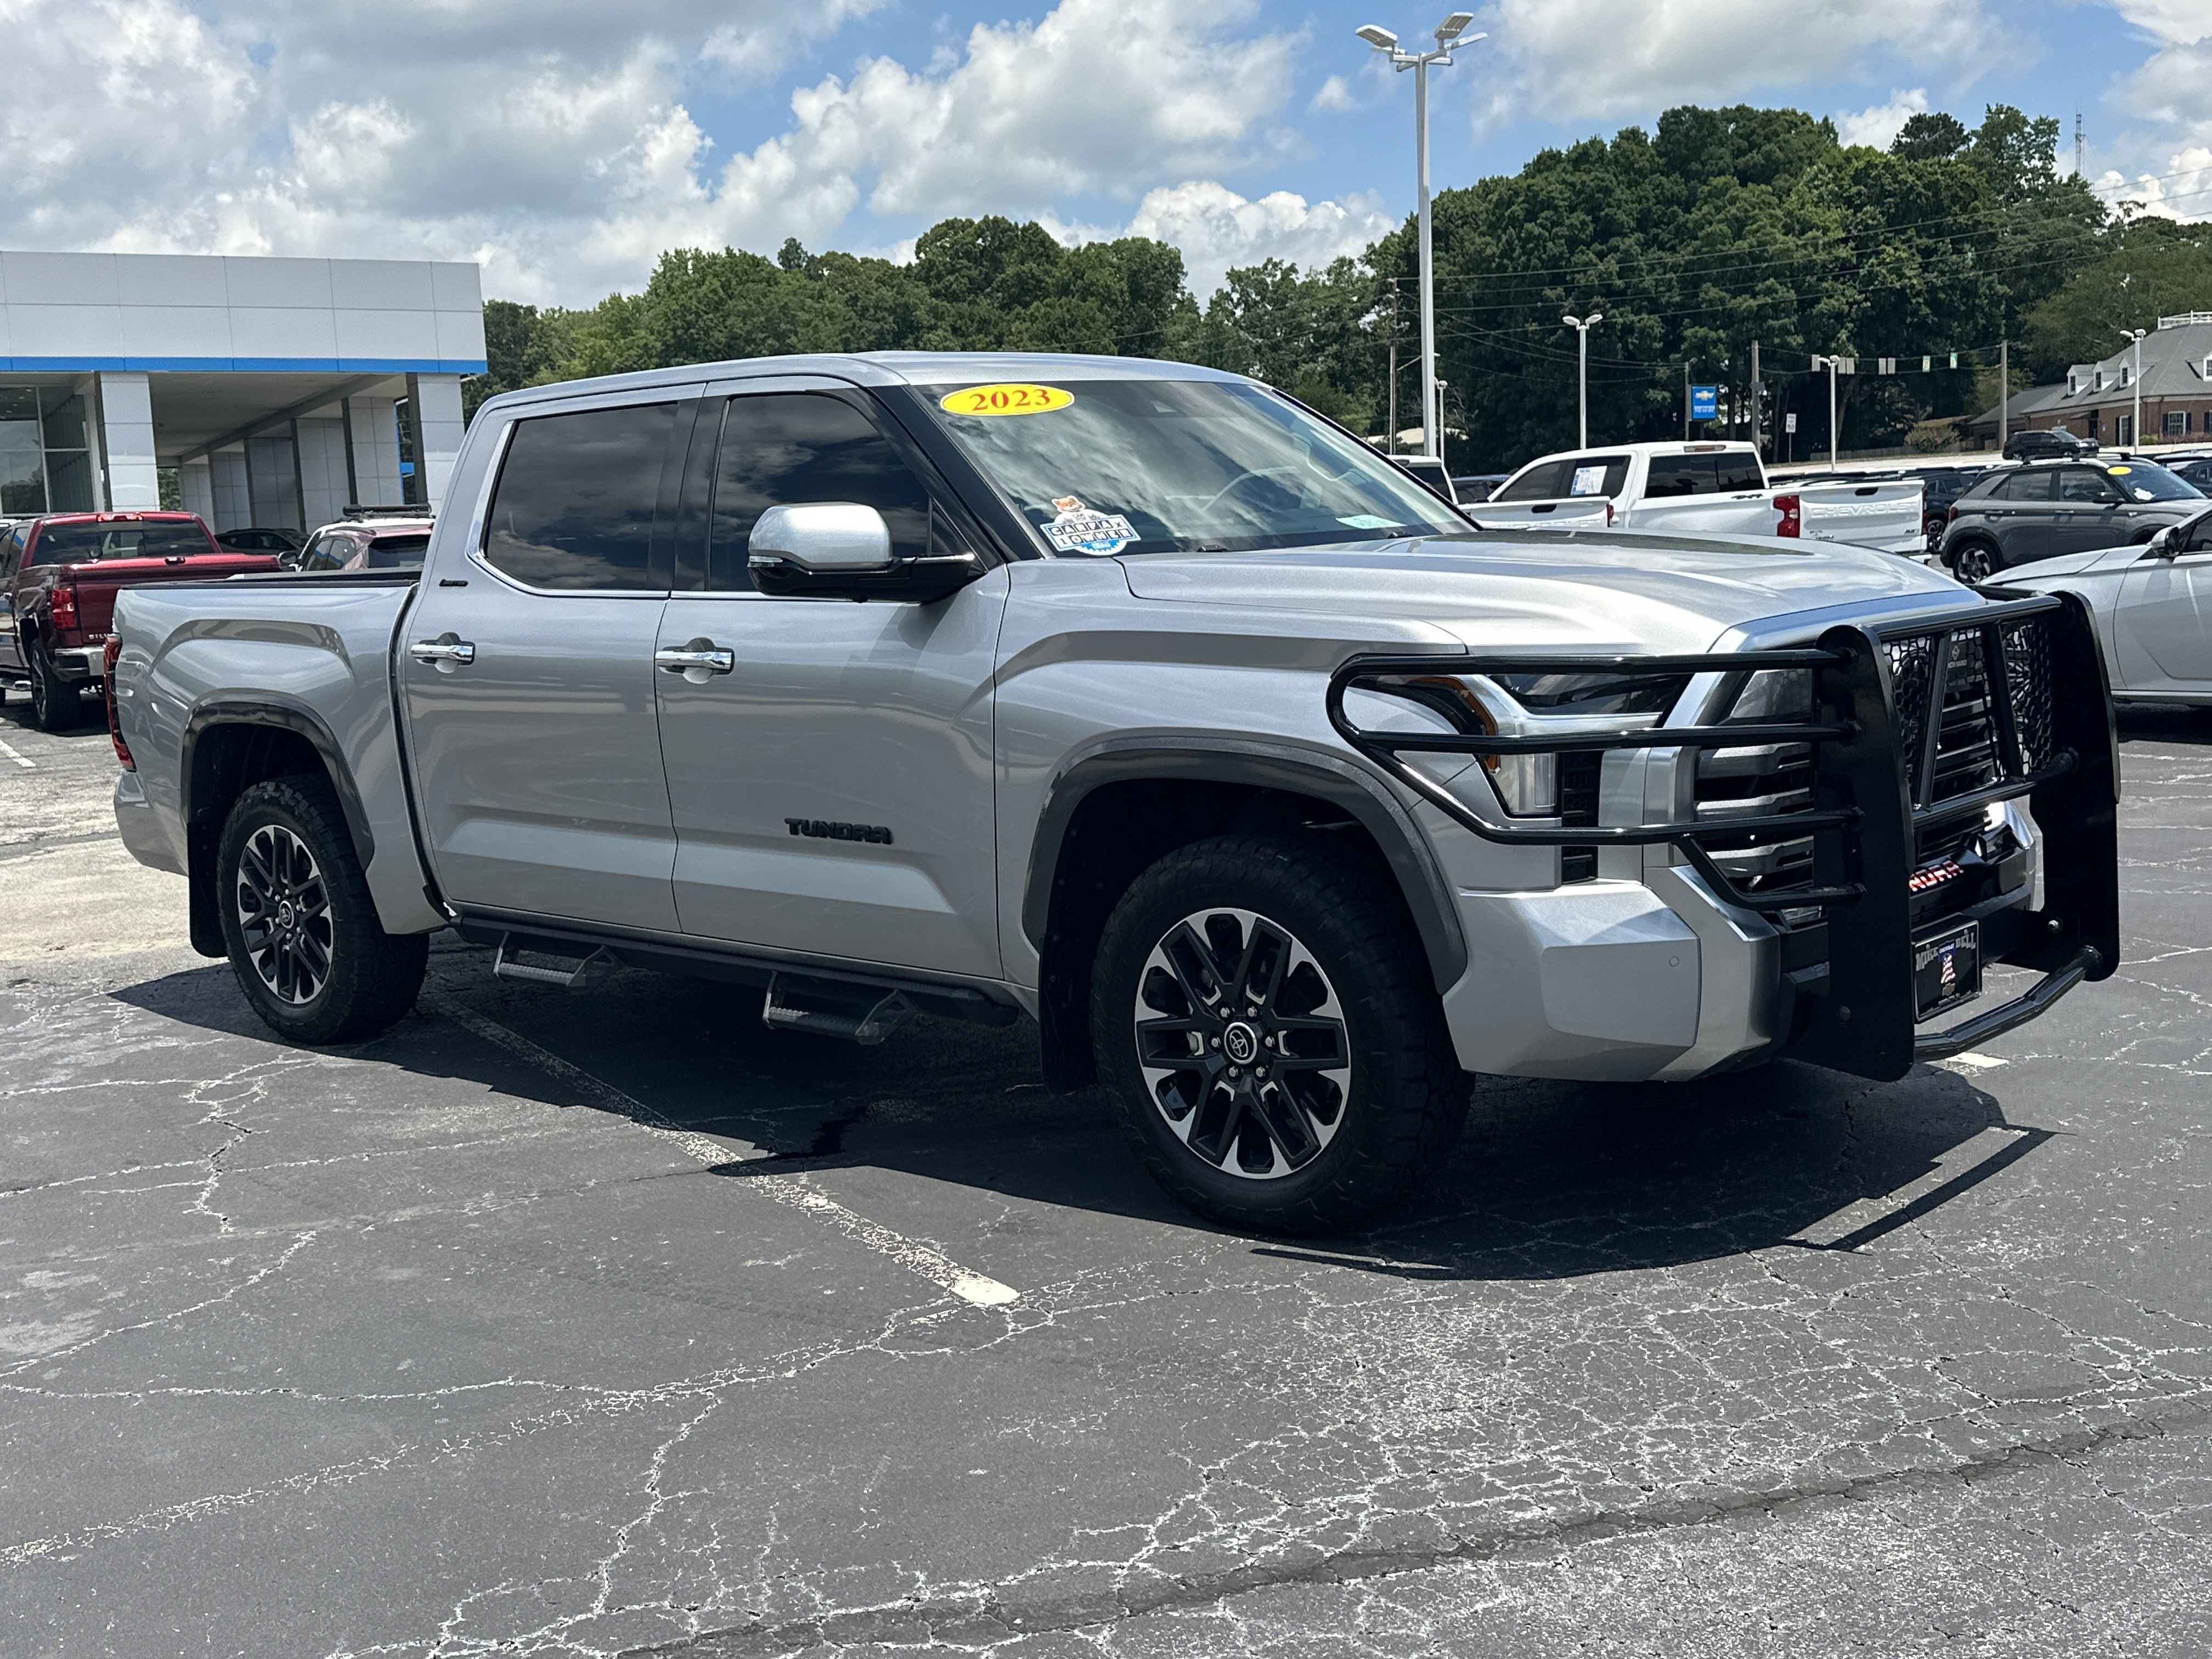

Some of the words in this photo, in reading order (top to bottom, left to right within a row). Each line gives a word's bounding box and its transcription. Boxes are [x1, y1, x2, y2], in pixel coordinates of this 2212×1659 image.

[969, 388, 1051, 411] 2023
[1811, 501, 1918, 518] CHEVROLET
[1049, 520, 1123, 536] CARFAX
[1069, 528, 1133, 545] OWNER
[784, 817, 893, 845] TUNDRA
[1915, 946, 1939, 972] MIKE
[1955, 932, 1976, 950] BELL
